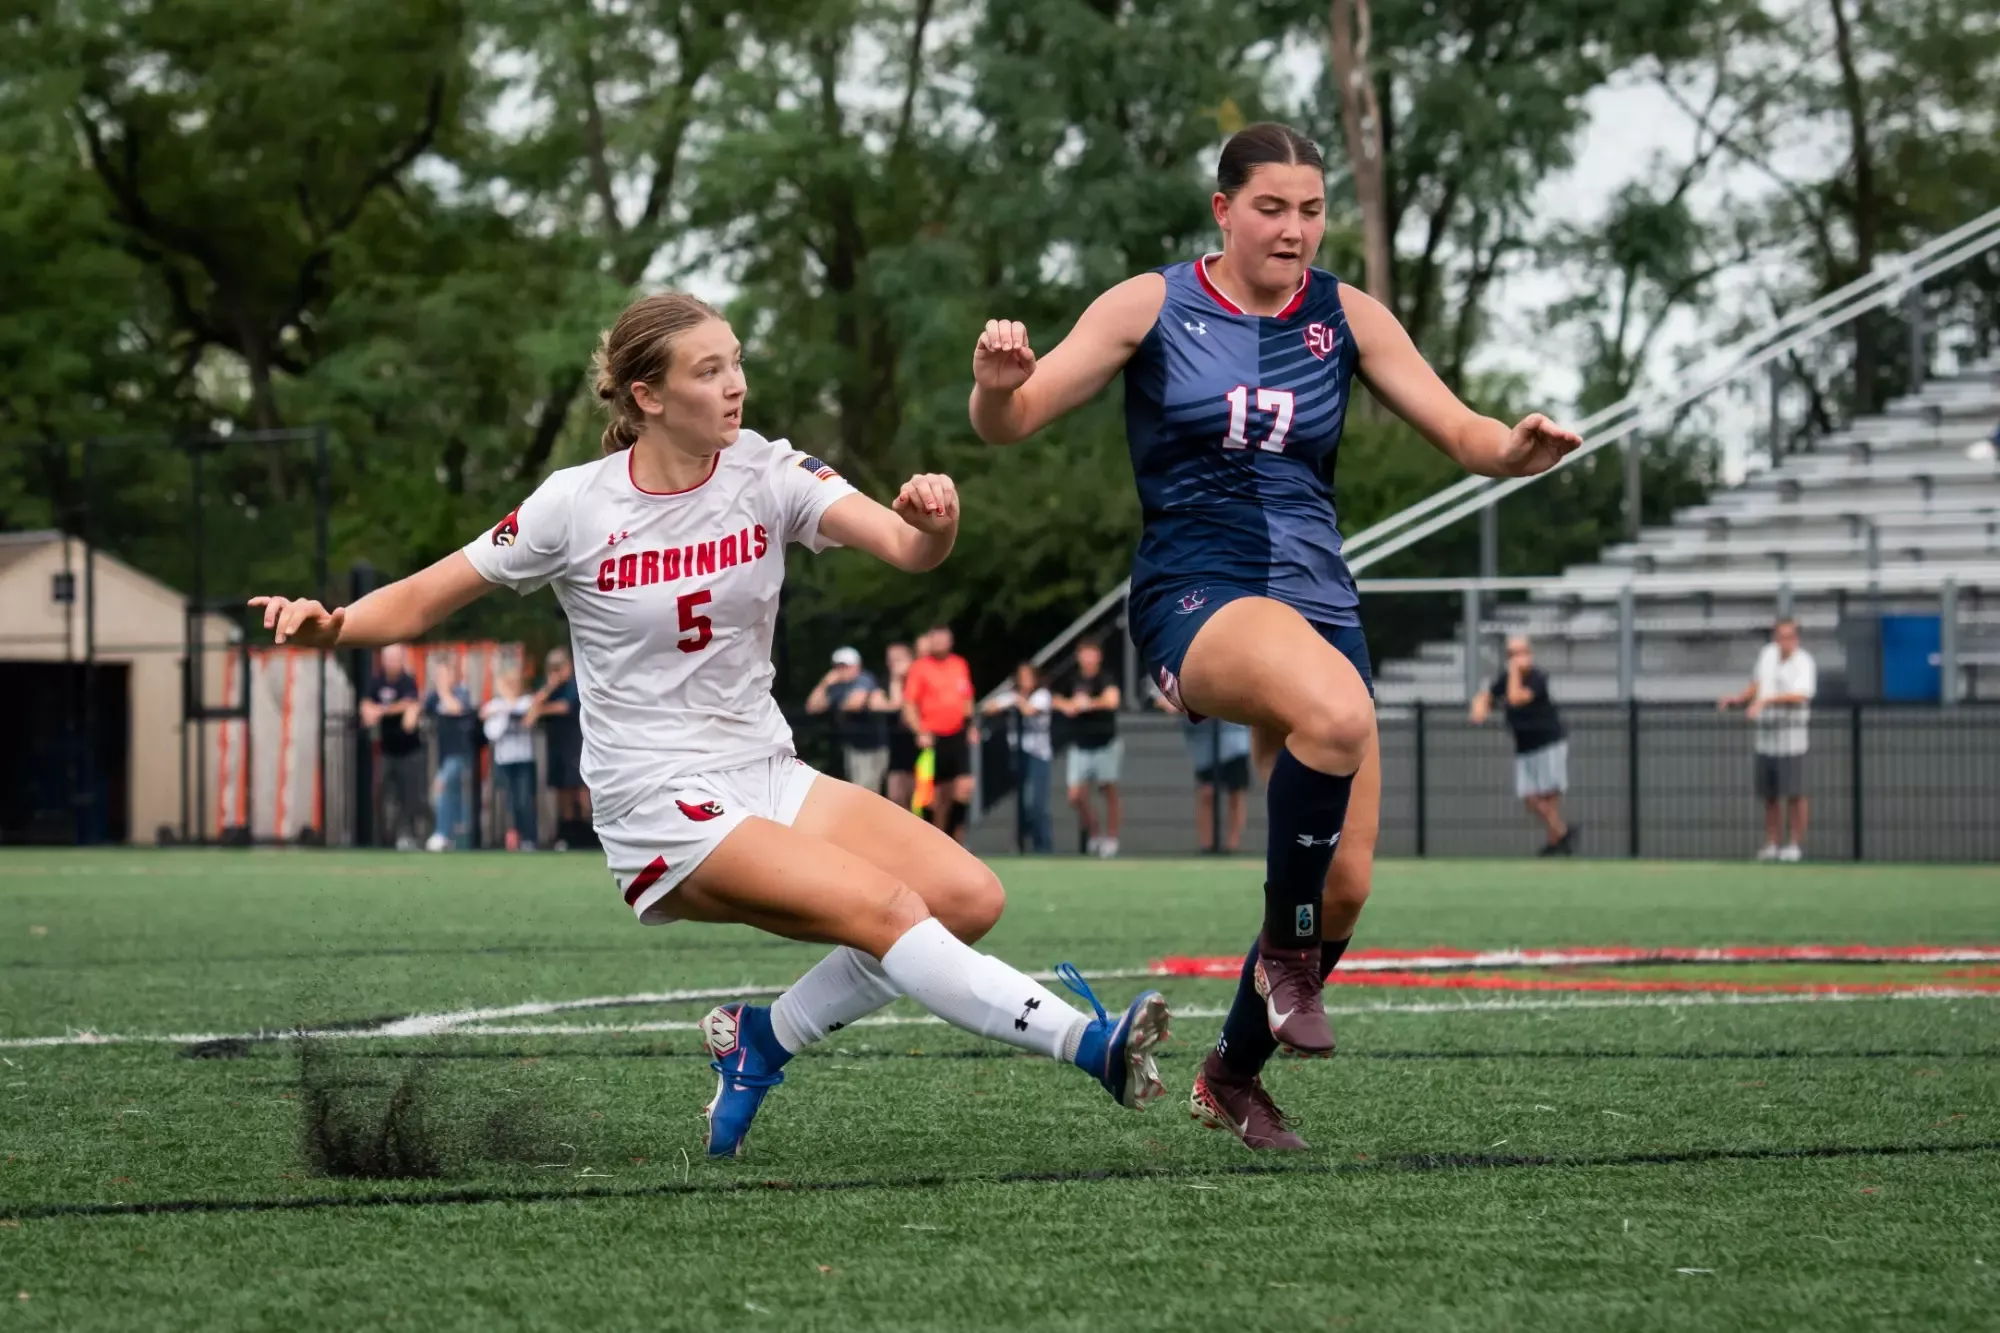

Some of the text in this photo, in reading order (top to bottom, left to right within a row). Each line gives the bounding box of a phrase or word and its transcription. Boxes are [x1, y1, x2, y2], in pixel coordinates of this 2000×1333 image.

[1308, 323, 1334, 353] SU
[1222, 385, 1295, 453] 17
[597, 523, 768, 592] CARDINALS
[676, 589, 713, 653] 5
